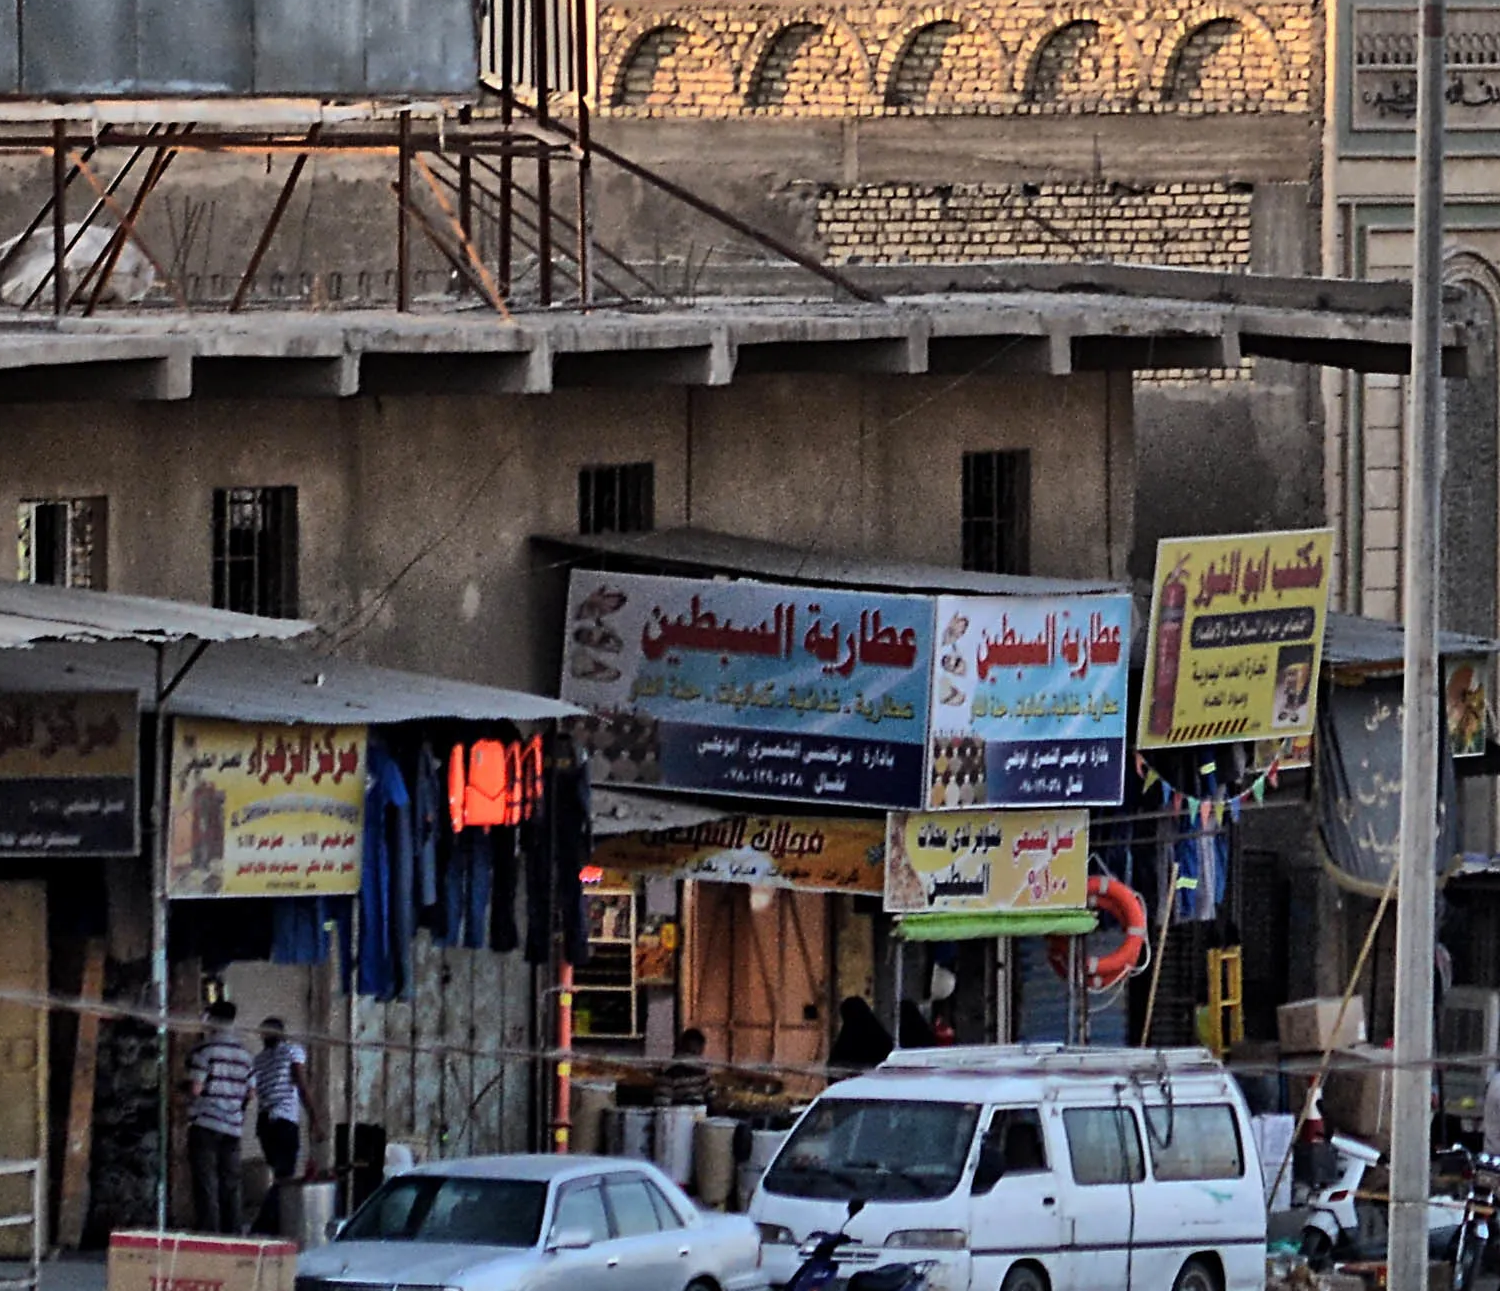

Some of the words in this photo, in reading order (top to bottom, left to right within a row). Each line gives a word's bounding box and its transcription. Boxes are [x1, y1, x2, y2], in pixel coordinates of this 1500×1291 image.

[1272, 540, 1323, 601] مكتب
[641, 592, 797, 667] السبطين
[803, 602, 918, 679] عطارية
[976, 610, 1058, 684] السبطين
[1059, 609, 1121, 682] عطارية
